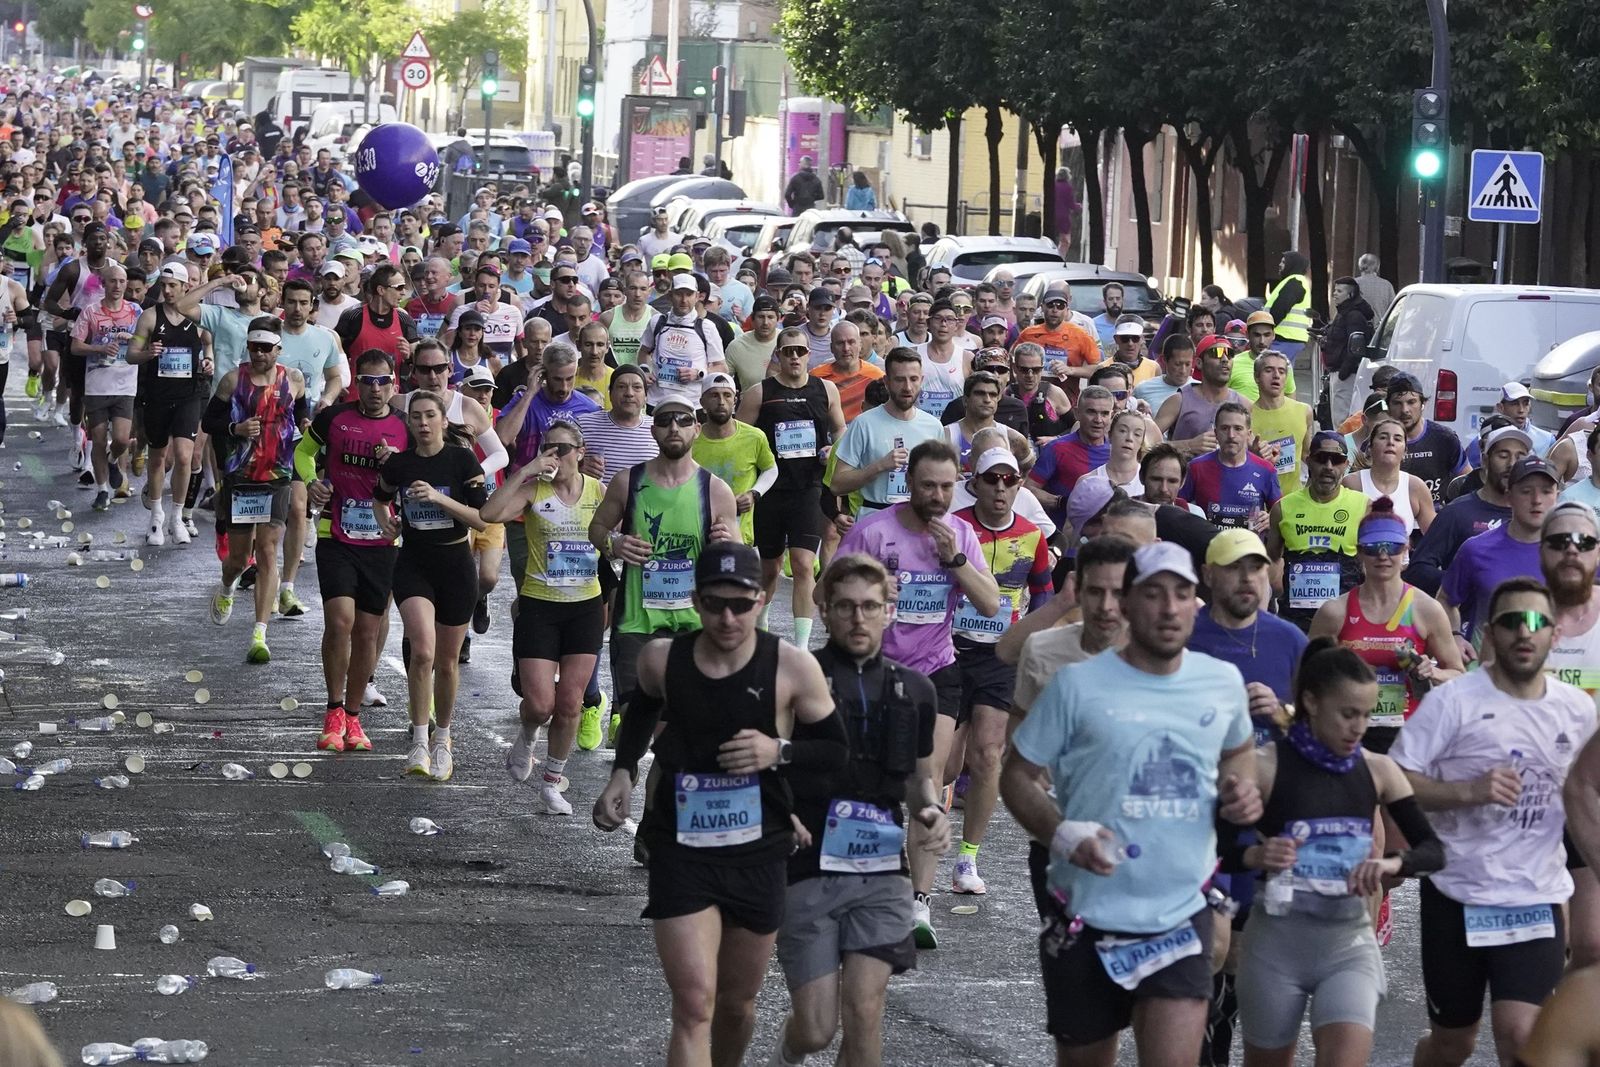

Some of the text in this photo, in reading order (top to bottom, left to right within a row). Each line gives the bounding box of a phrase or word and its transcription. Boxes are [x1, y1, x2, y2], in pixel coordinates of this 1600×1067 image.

[407, 69, 425, 80] 30
[239, 506, 265, 514] JAVITO
[411, 511, 446, 520] MARRIS
[1295, 523, 1347, 537] DEPORTEMANIA
[1309, 535, 1332, 546] ITZ
[576, 568, 597, 577] PEREA
[1305, 564, 1334, 572] ZURICH
[915, 574, 947, 582] ZURICH
[1292, 587, 1336, 598] VALENCIA
[960, 617, 1004, 632] ROMERO
[703, 776, 750, 788] ZURICH
[705, 799, 731, 810] 9302
[1121, 798, 1200, 821] SEVILLA
[690, 810, 749, 829] ÁLVARO
[847, 842, 881, 856] MAX
[1467, 910, 1551, 929] CASTIGADOR
